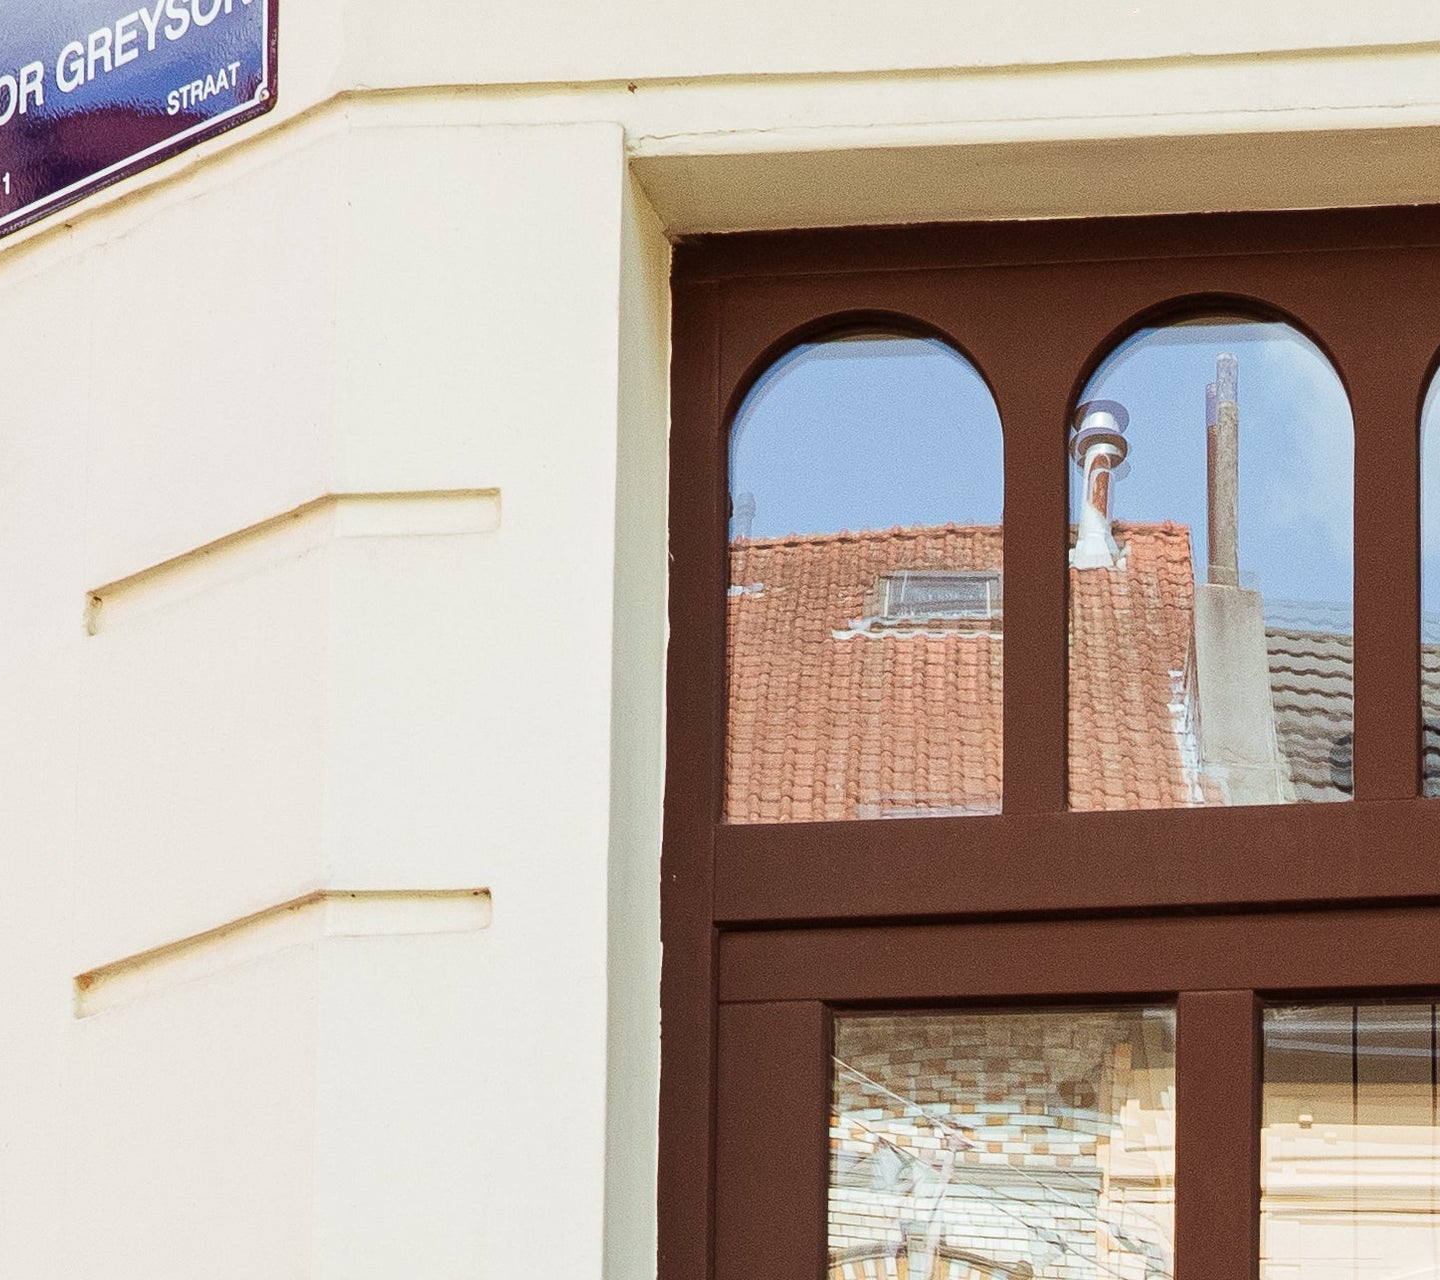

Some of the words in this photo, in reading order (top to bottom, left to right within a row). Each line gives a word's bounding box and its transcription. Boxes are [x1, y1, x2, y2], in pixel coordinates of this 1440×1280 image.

[56, 0, 252, 93] GREYSO
[166, 61, 242, 116] STRAAT
[2, 172, 11, 195] 1
